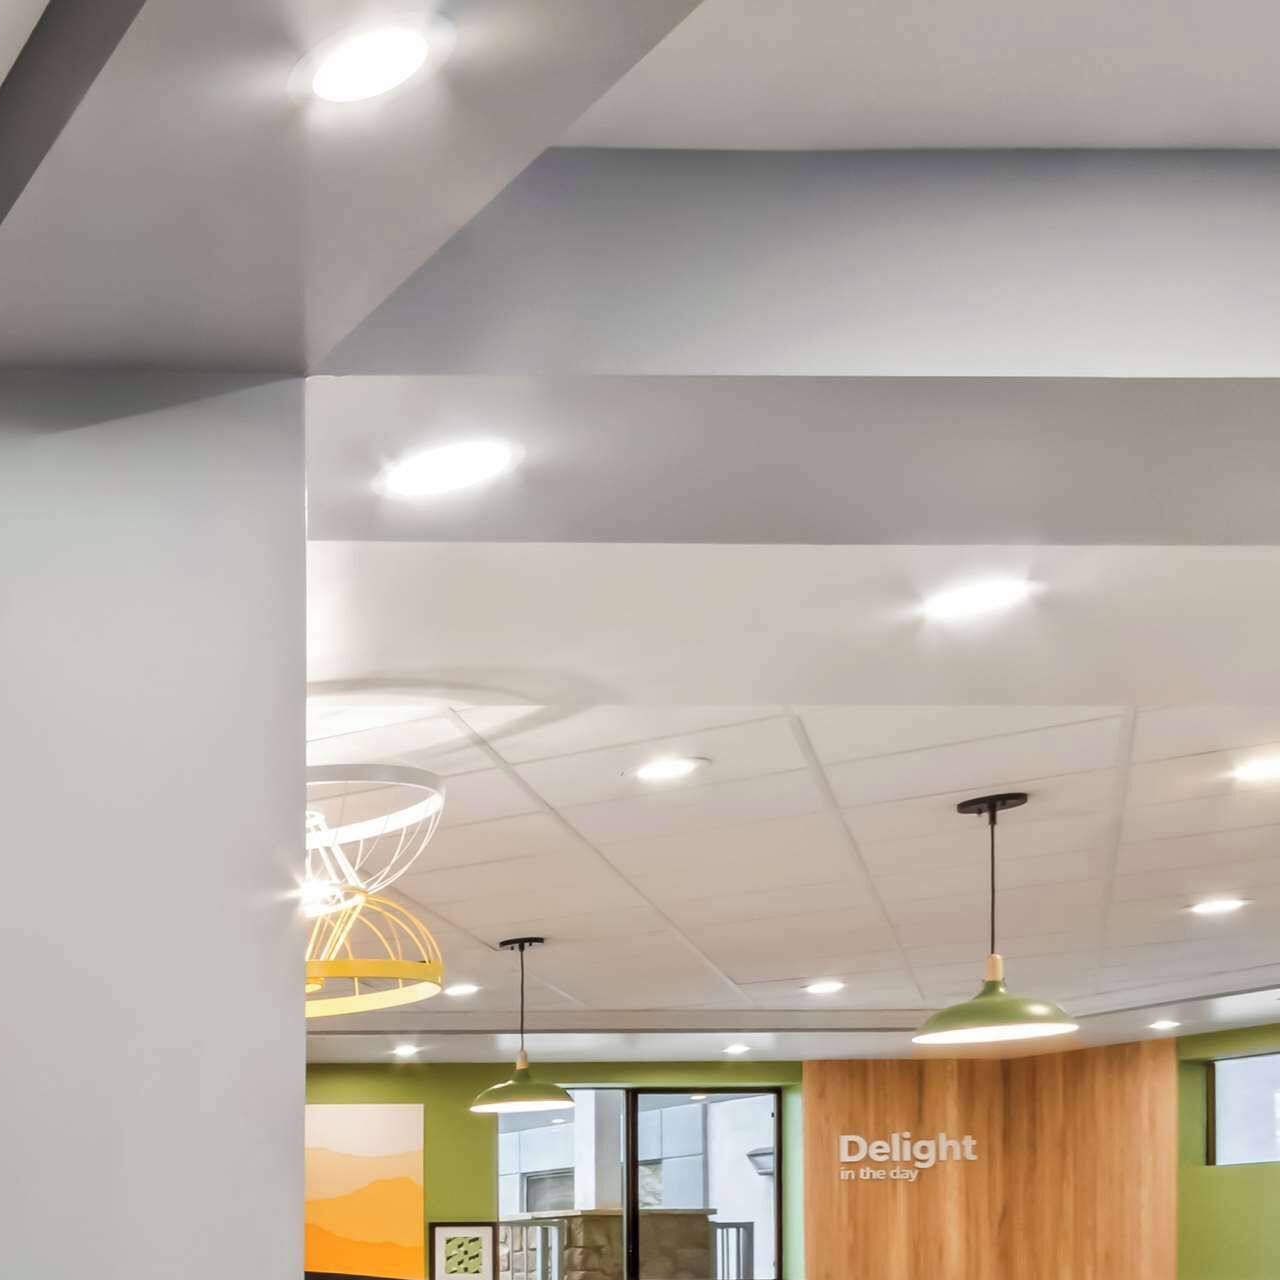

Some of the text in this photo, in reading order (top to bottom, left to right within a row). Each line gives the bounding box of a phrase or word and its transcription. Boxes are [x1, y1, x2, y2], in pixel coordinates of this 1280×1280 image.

[839, 1131, 979, 1169] Delight
[840, 1165, 920, 1183] in the day
